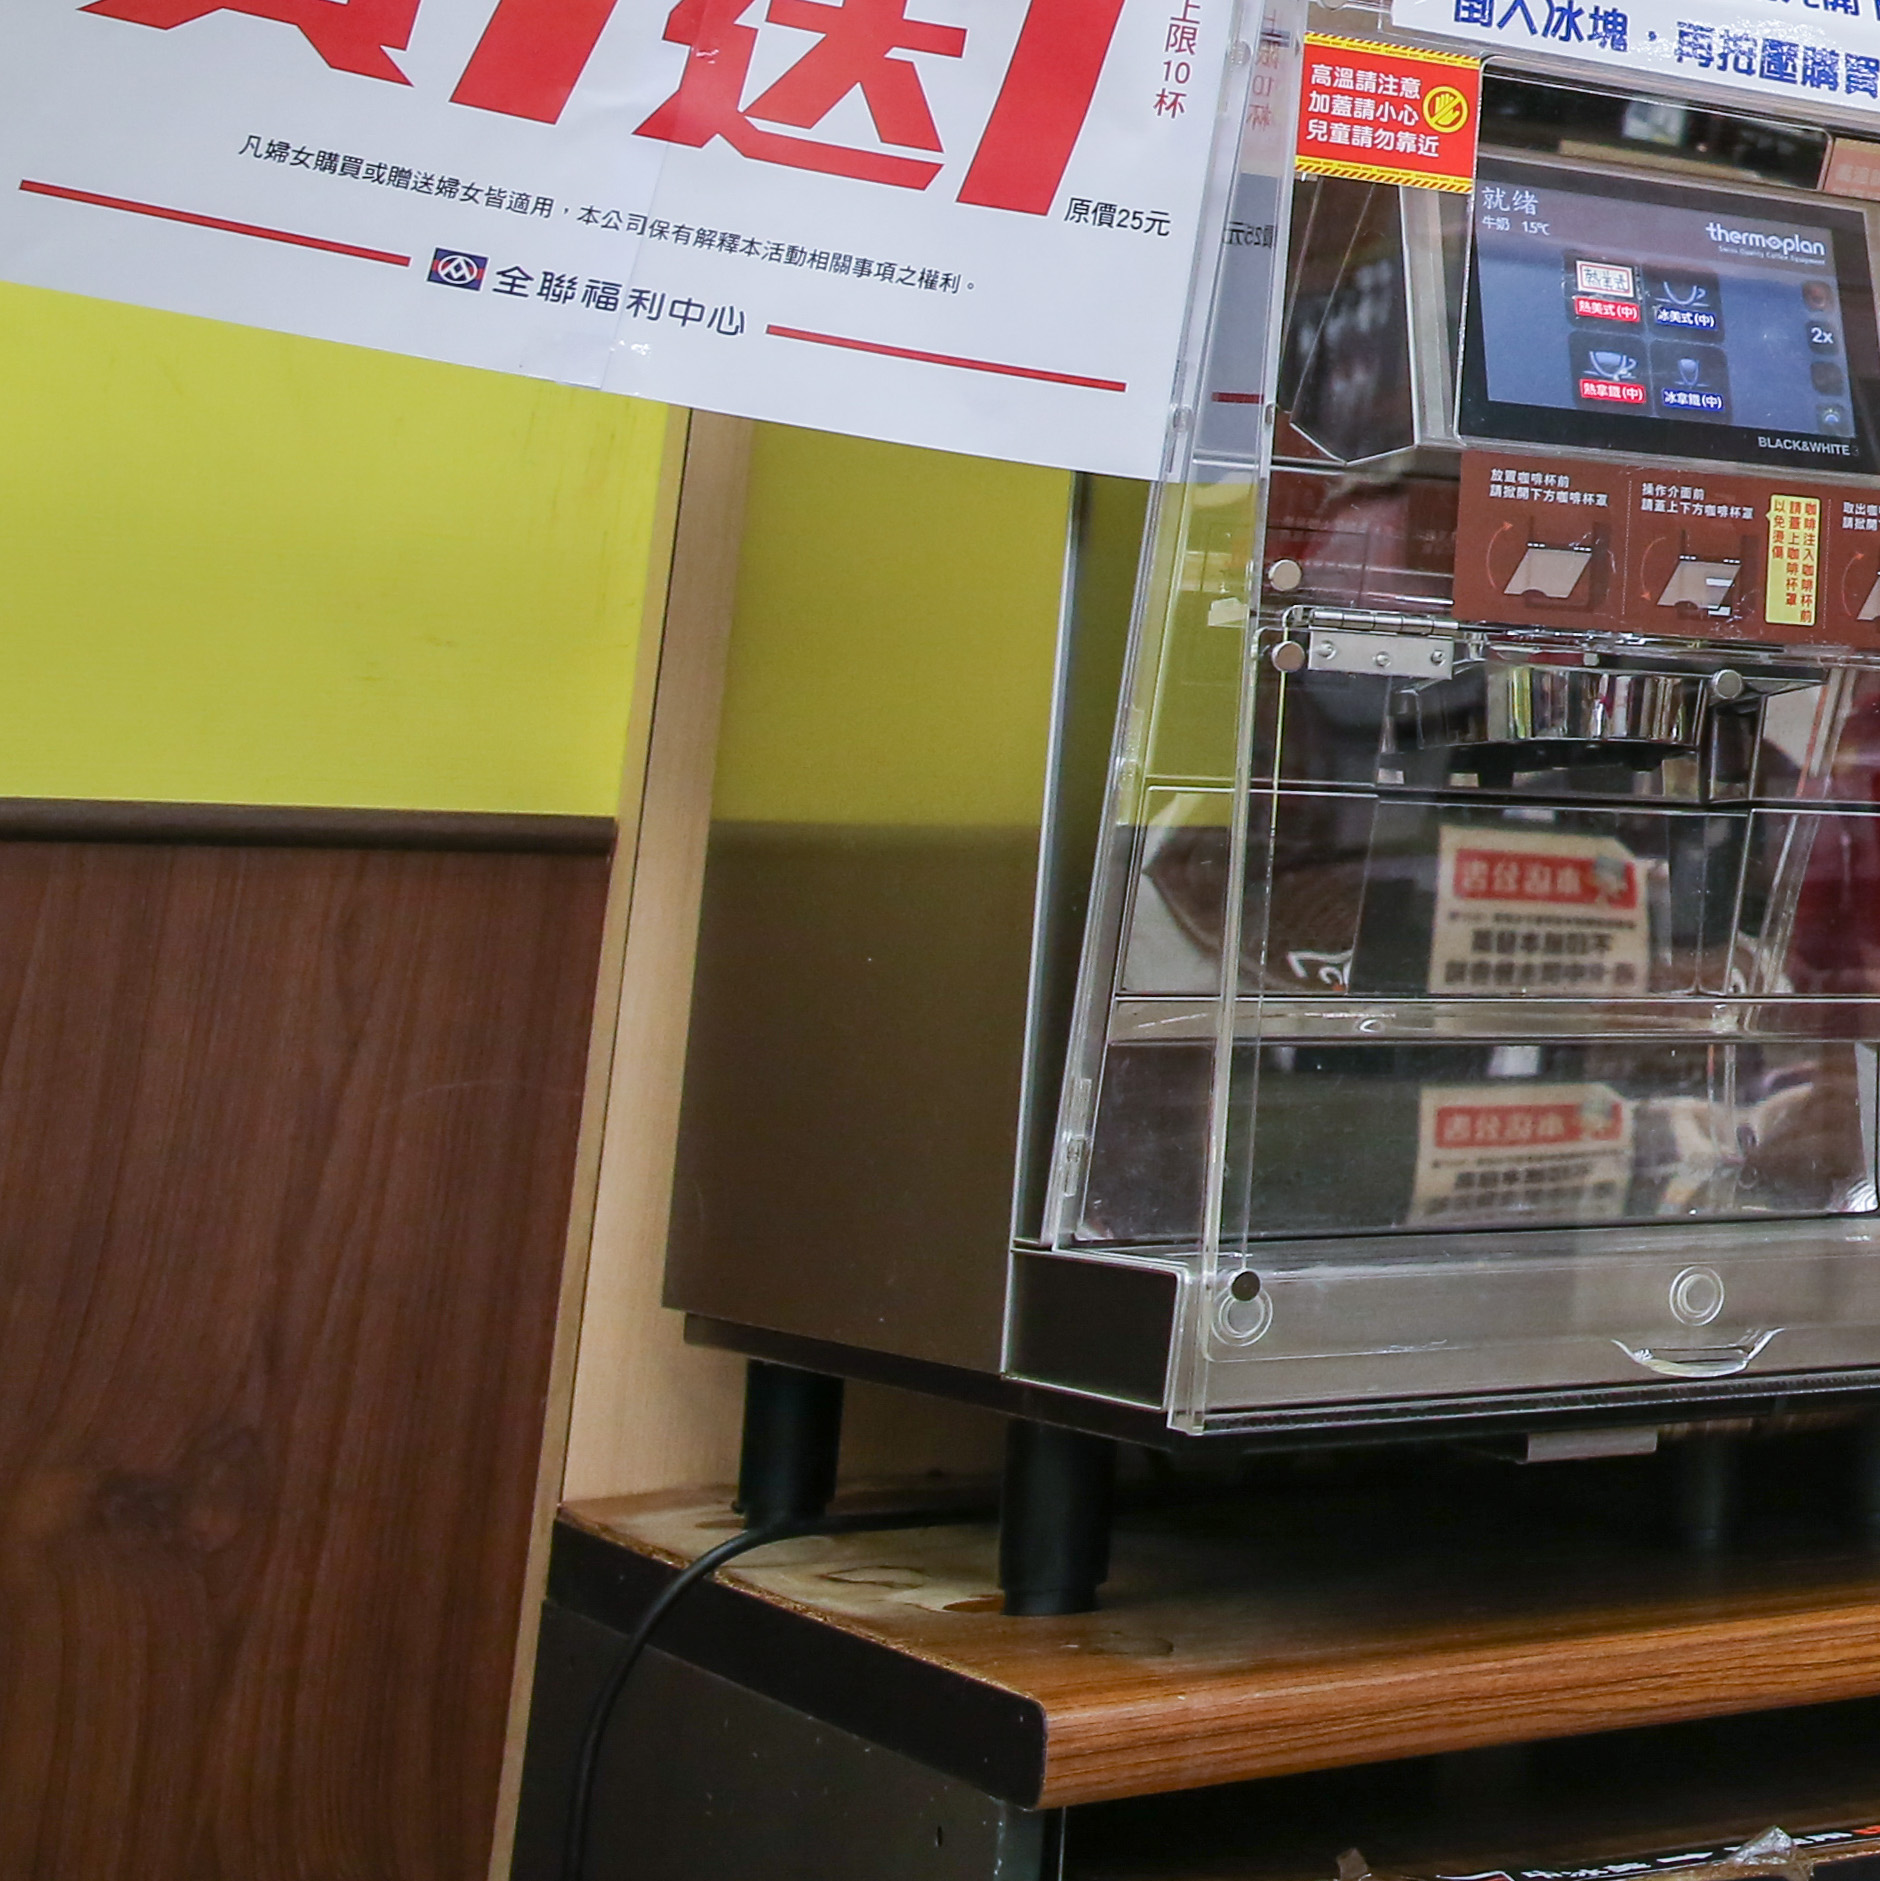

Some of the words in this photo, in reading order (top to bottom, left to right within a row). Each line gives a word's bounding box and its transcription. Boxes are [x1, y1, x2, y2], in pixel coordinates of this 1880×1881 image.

[1311, 63, 1421, 100] 高溫請注意
[1308, 90, 1420, 127] 加蓋請小心
[1306, 118, 1440, 158] 兒童請勿靠近
[1063, 196, 1172, 238] 原價25元
[1481, 185, 1540, 217] 就绪
[1481, 214, 1511, 232] 牛奶
[1705, 222, 1826, 257] thermoplan
[491, 263, 748, 338] 全聯福利中心
[1578, 298, 1639, 320] 熱美式(中)
[1657, 309, 1716, 329] 冰美式(中)
[1810, 328, 1834, 345] 2x
[1758, 436, 1850, 457] BLACK&WHITE
[1641, 481, 1705, 501] 操作介面前
